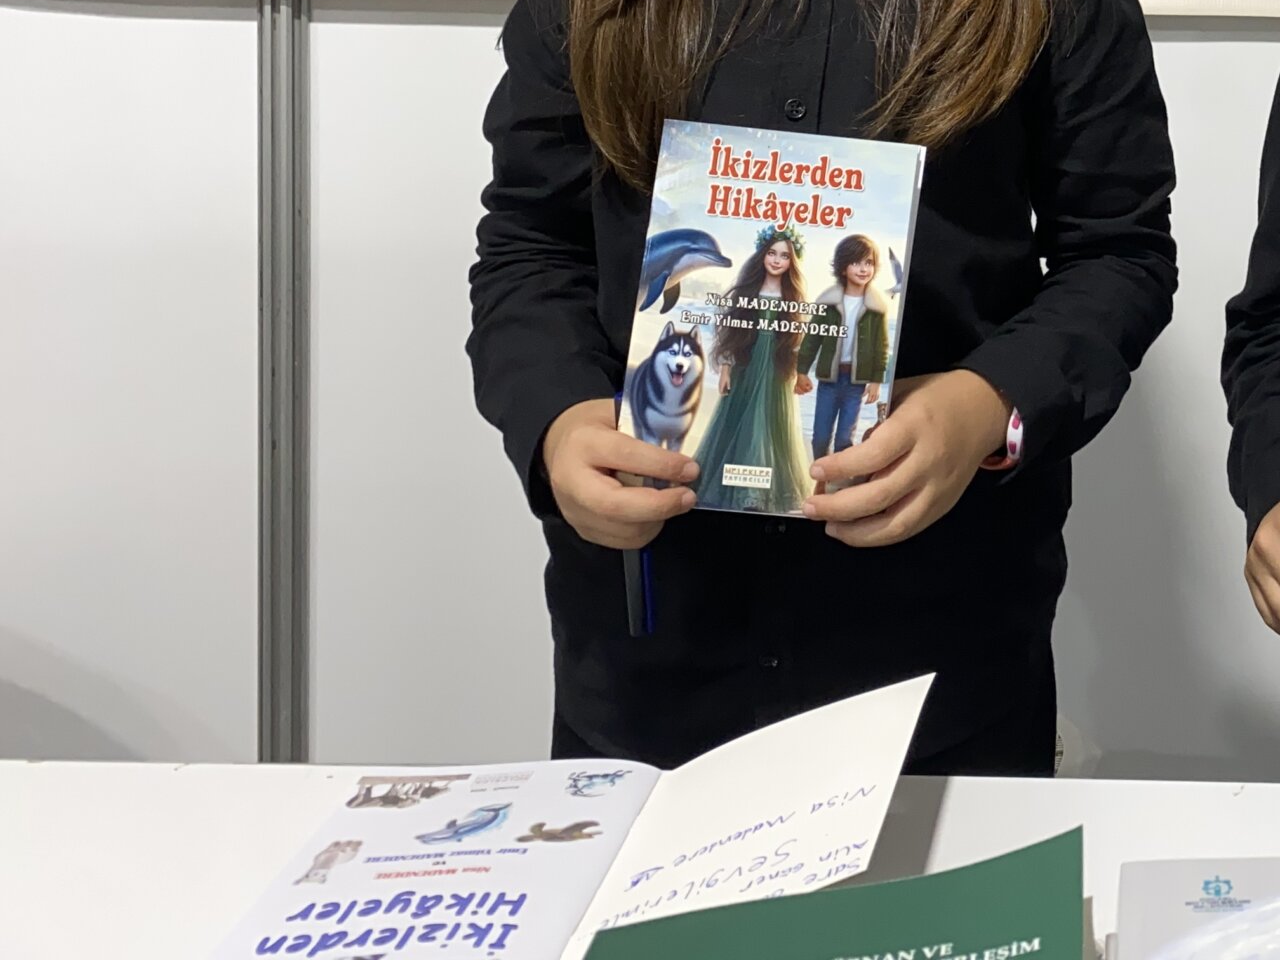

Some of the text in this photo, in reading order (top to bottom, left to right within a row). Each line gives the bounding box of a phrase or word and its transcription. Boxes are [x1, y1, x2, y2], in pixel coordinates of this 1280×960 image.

[707, 138, 866, 192] İkizlerden
[706, 183, 854, 231] Hikâyeler
[705, 292, 829, 317] Nisa MADENDERE
[680, 310, 849, 339] Emir Yılmaz MADENDERE
[285, 890, 528, 925] Hikâyeler
[254, 922, 519, 958] İkizlerden
[921, 942, 954, 960] VE
